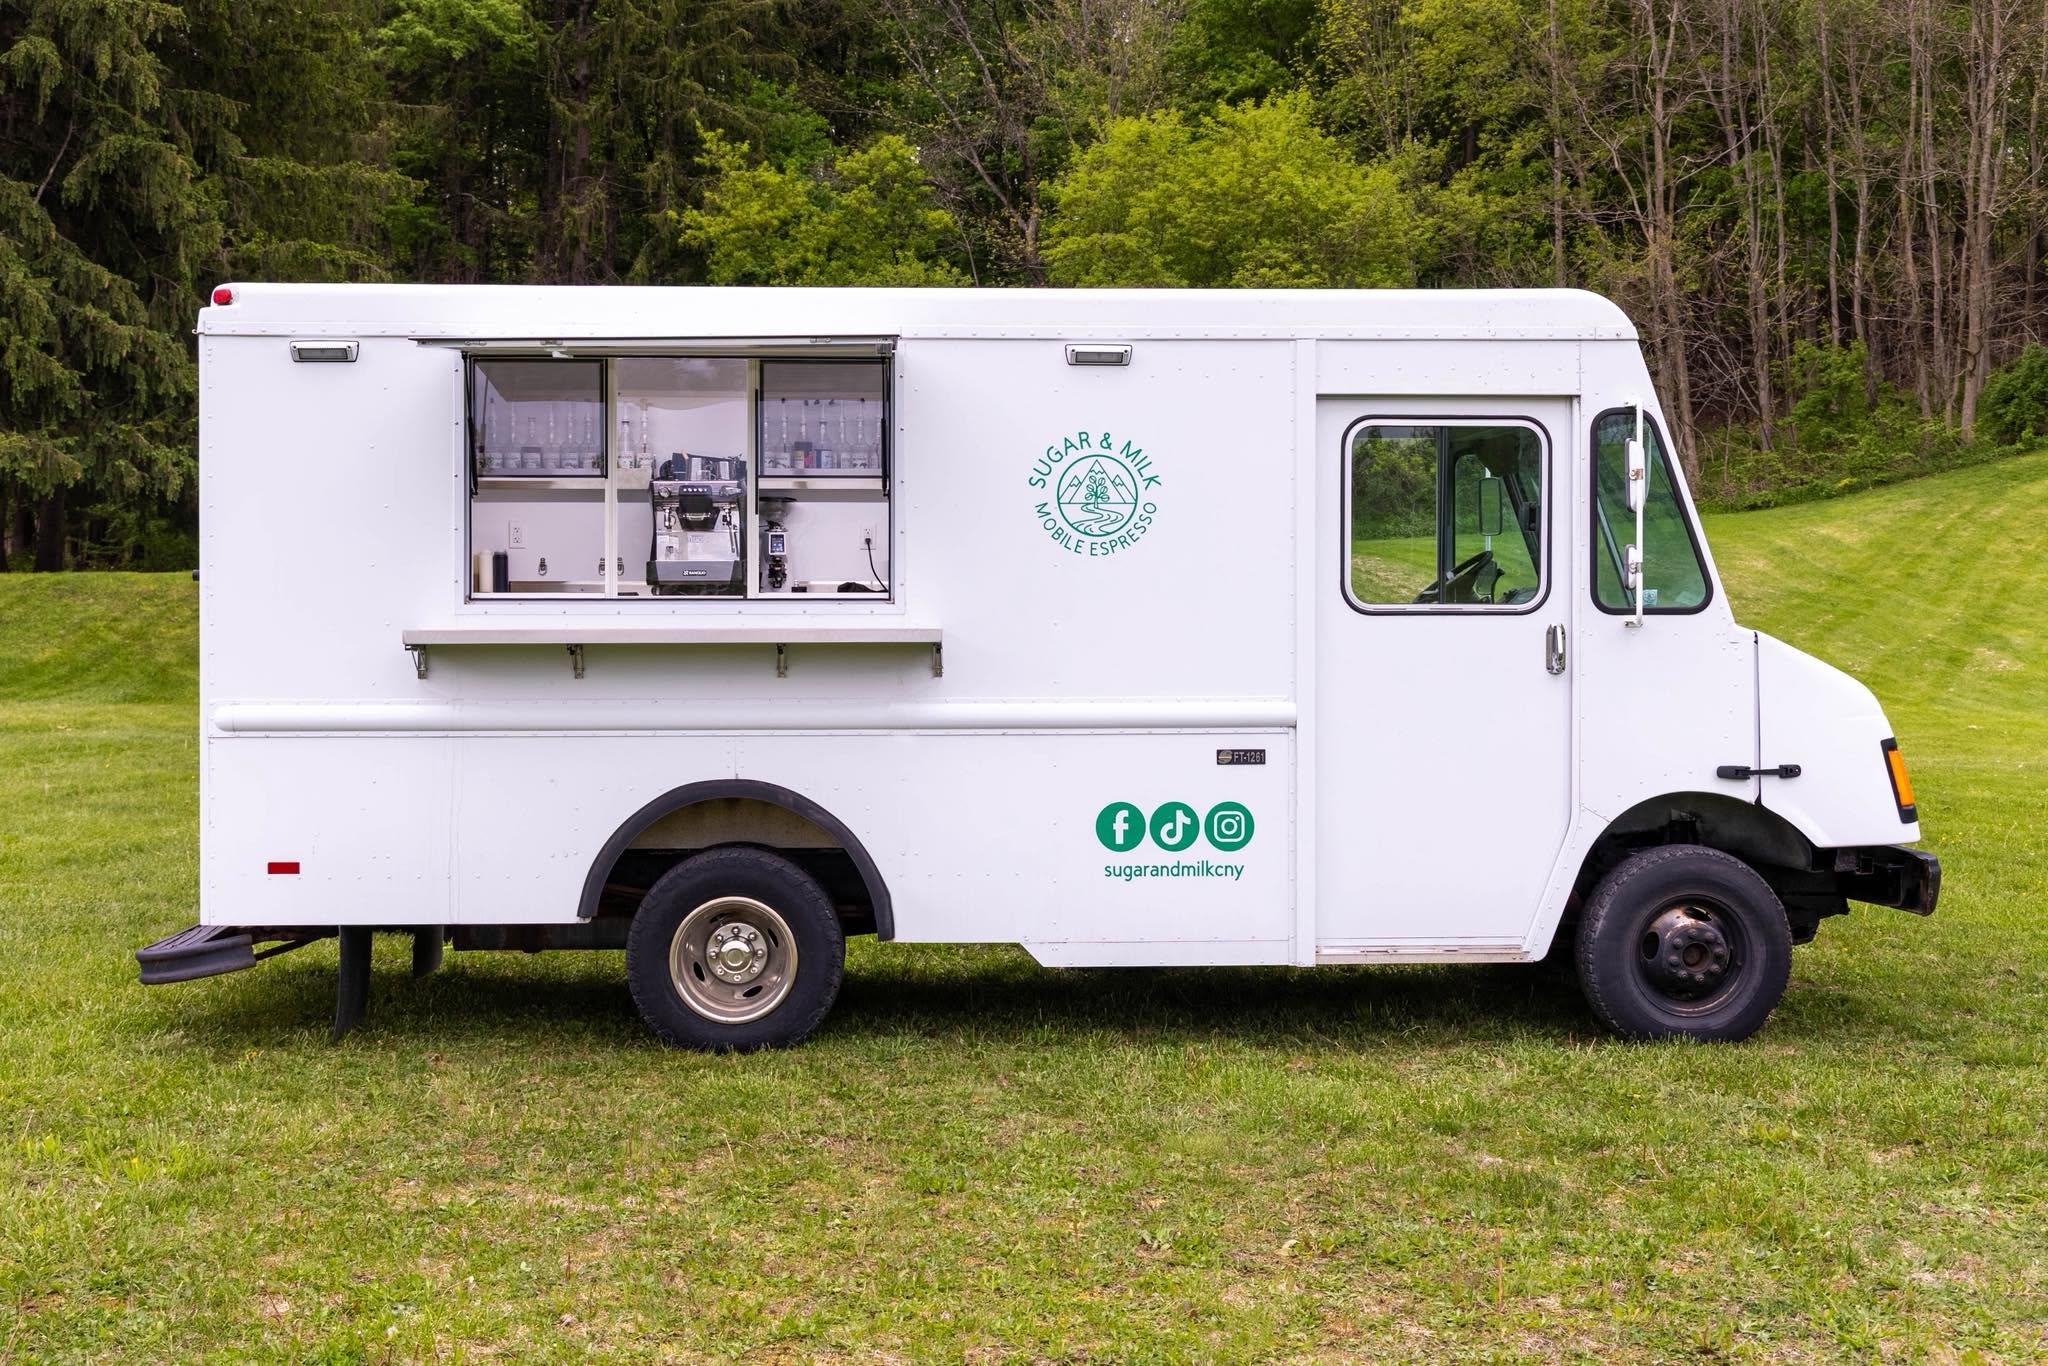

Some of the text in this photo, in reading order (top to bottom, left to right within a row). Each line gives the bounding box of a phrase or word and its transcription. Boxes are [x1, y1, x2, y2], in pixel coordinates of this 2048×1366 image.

[1028, 431, 1162, 491] SUGAR & MILK
[1035, 502, 1157, 556] MOBILE ESPRESSO
[1233, 751, 1265, 763] FT-1261
[1104, 860, 1245, 881] sugarandmilkcny
